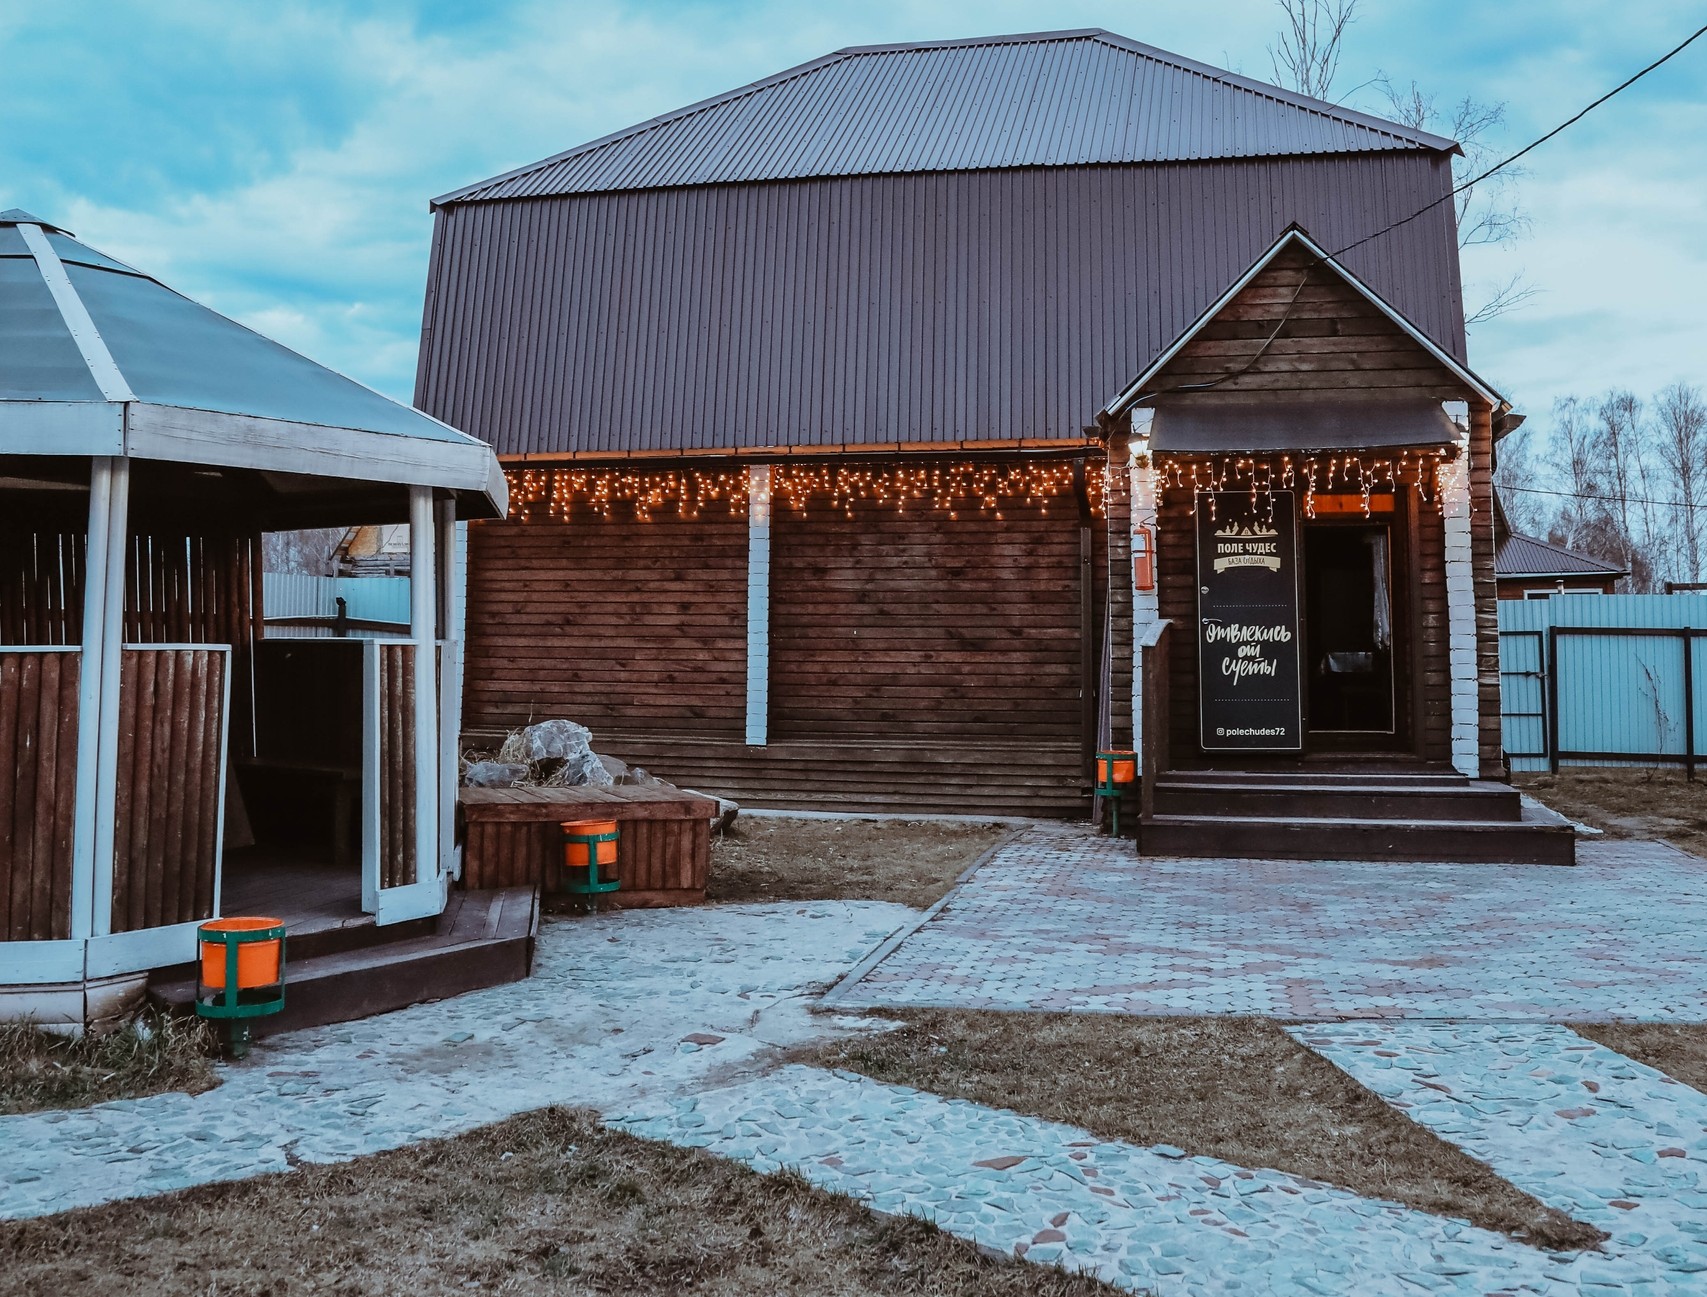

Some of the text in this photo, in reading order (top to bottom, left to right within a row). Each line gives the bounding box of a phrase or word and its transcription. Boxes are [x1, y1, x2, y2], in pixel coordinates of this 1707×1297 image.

[1217, 543, 1277, 554] ПОЛЕ ЧУДЕС
[1227, 557, 1266, 565] БАЗА ОТДЫХА
[1237, 642, 1260, 658] от
[1226, 727, 1286, 737] polechudes72
